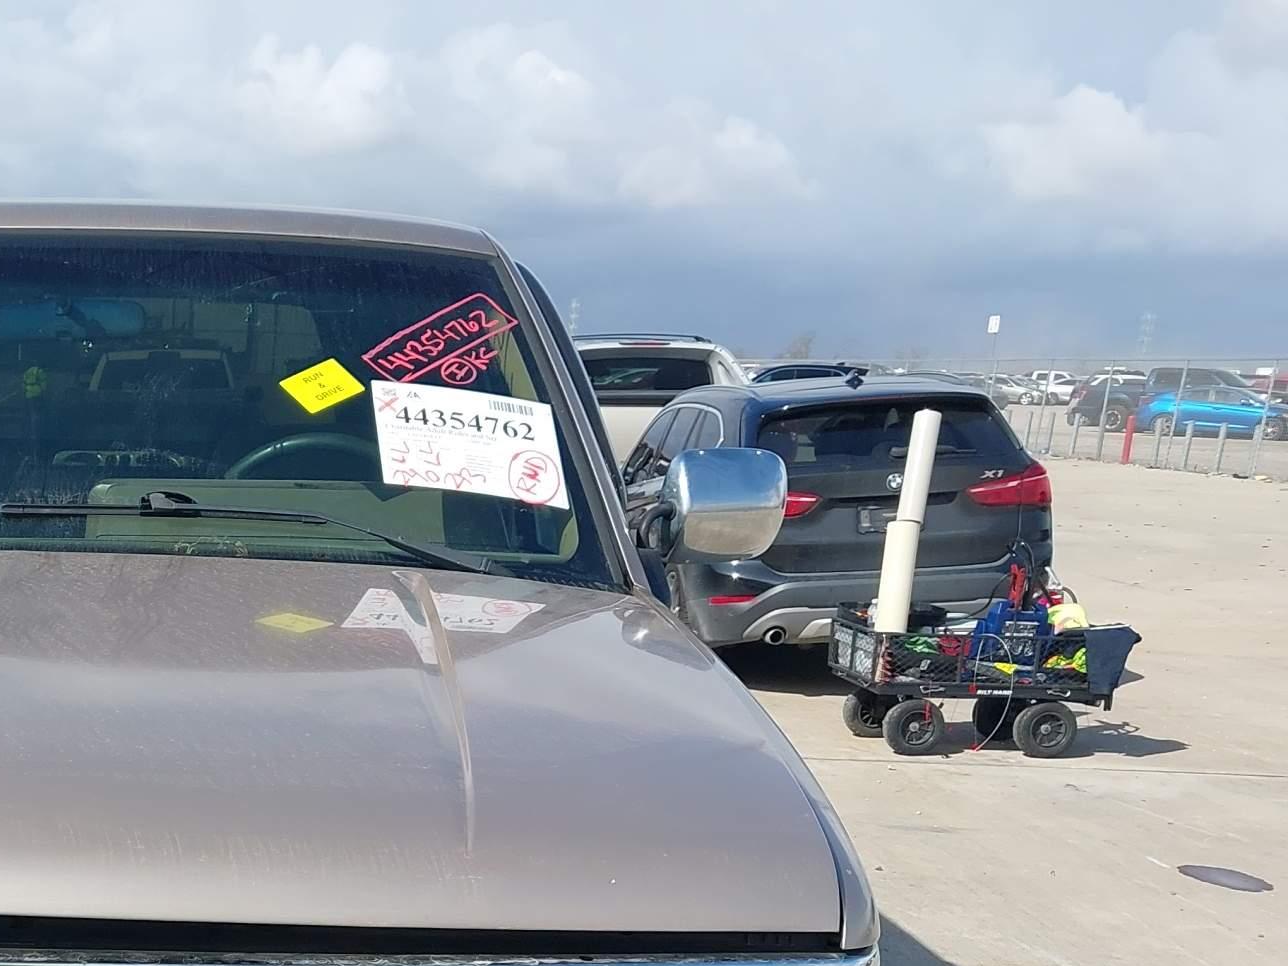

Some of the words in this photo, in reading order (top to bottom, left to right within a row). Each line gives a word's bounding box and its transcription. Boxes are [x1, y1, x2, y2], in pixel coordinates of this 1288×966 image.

[377, 310, 500, 370] 44354762
[302, 371, 324, 384] RUN
[315, 385, 344, 401] DRIVE
[395, 406, 536, 441] 44354762
[979, 469, 1005, 479] X1
